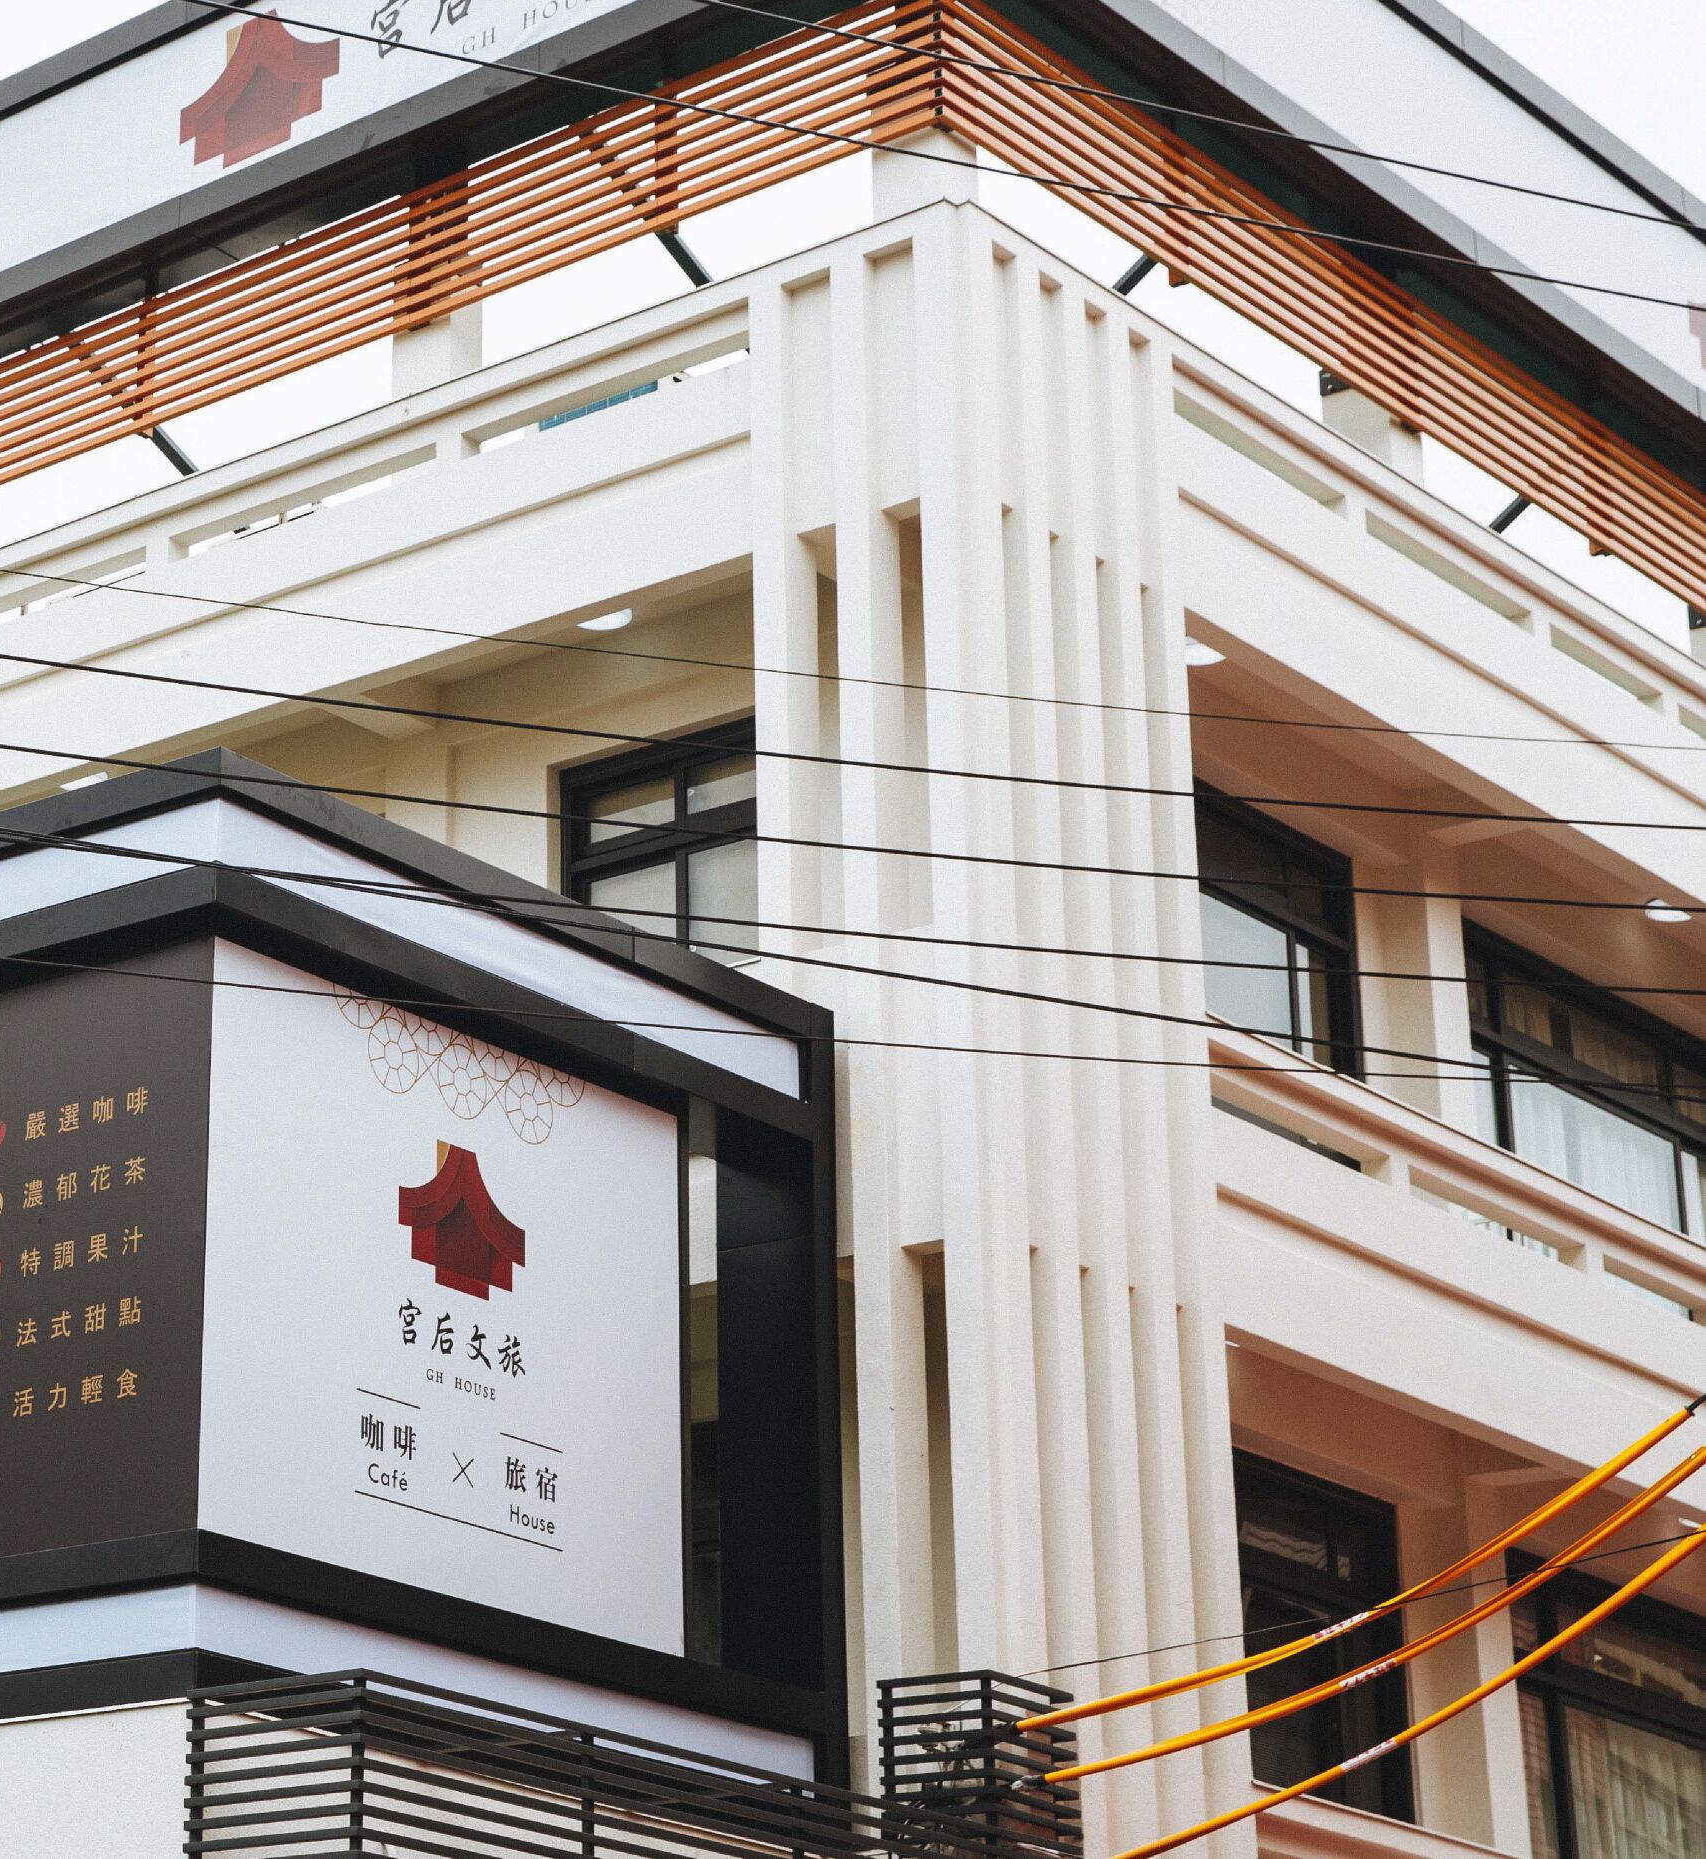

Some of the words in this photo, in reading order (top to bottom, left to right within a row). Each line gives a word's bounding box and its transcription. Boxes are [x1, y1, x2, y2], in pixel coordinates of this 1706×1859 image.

[462, 27, 495, 55] GH
[24, 1086, 149, 1141] 嚴選咖啡
[22, 1156, 146, 1209] 濃郁花茶
[20, 1226, 144, 1278] 特調果汁
[16, 1296, 142, 1347] 法式甜點
[398, 1298, 526, 1378] 宮后文旅
[12, 1368, 139, 1418] 活力輕食
[426, 1368, 444, 1385] GH
[454, 1376, 497, 1401] HOUSE
[360, 1413, 417, 1461] 咖啡
[505, 1456, 558, 1503] 旅宿
[367, 1463, 408, 1491] Café
[509, 1504, 556, 1535] House
